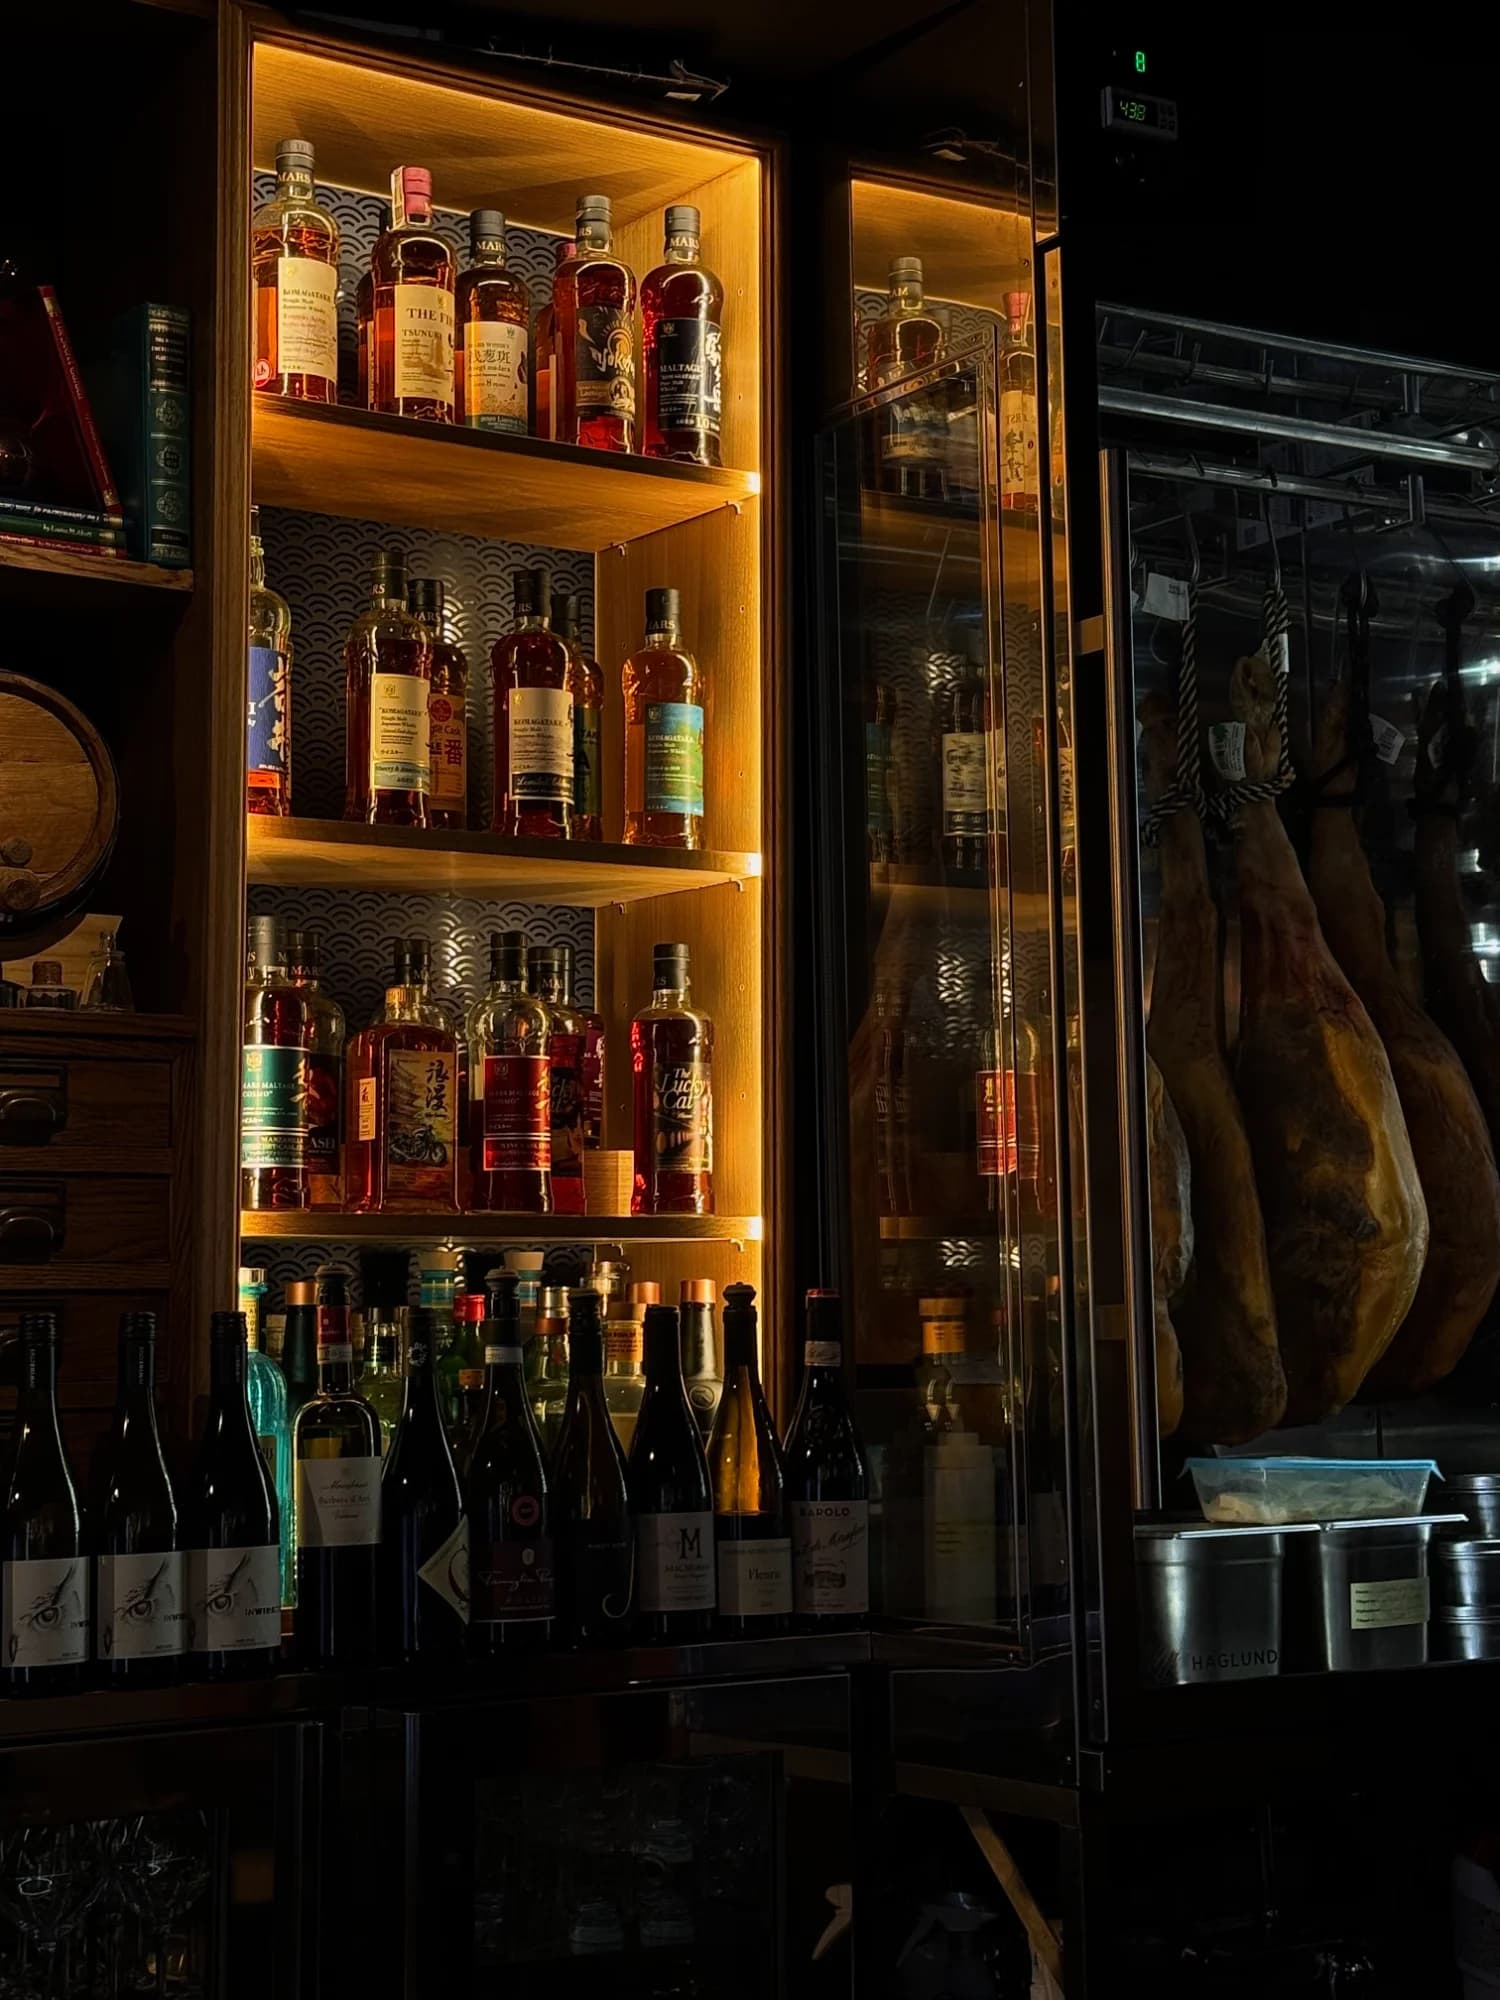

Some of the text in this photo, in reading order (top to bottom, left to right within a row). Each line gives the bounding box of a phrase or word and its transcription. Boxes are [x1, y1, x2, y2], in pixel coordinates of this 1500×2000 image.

[406, 308, 437, 320] THE
[673, 1068, 692, 1079] The
[660, 1072, 706, 1098] Lucky
[662, 1089, 695, 1110] Cat
[800, 1507, 850, 1517] BAROLO
[680, 1528, 702, 1559] M
[1192, 1650, 1278, 1670] HAGLUND
